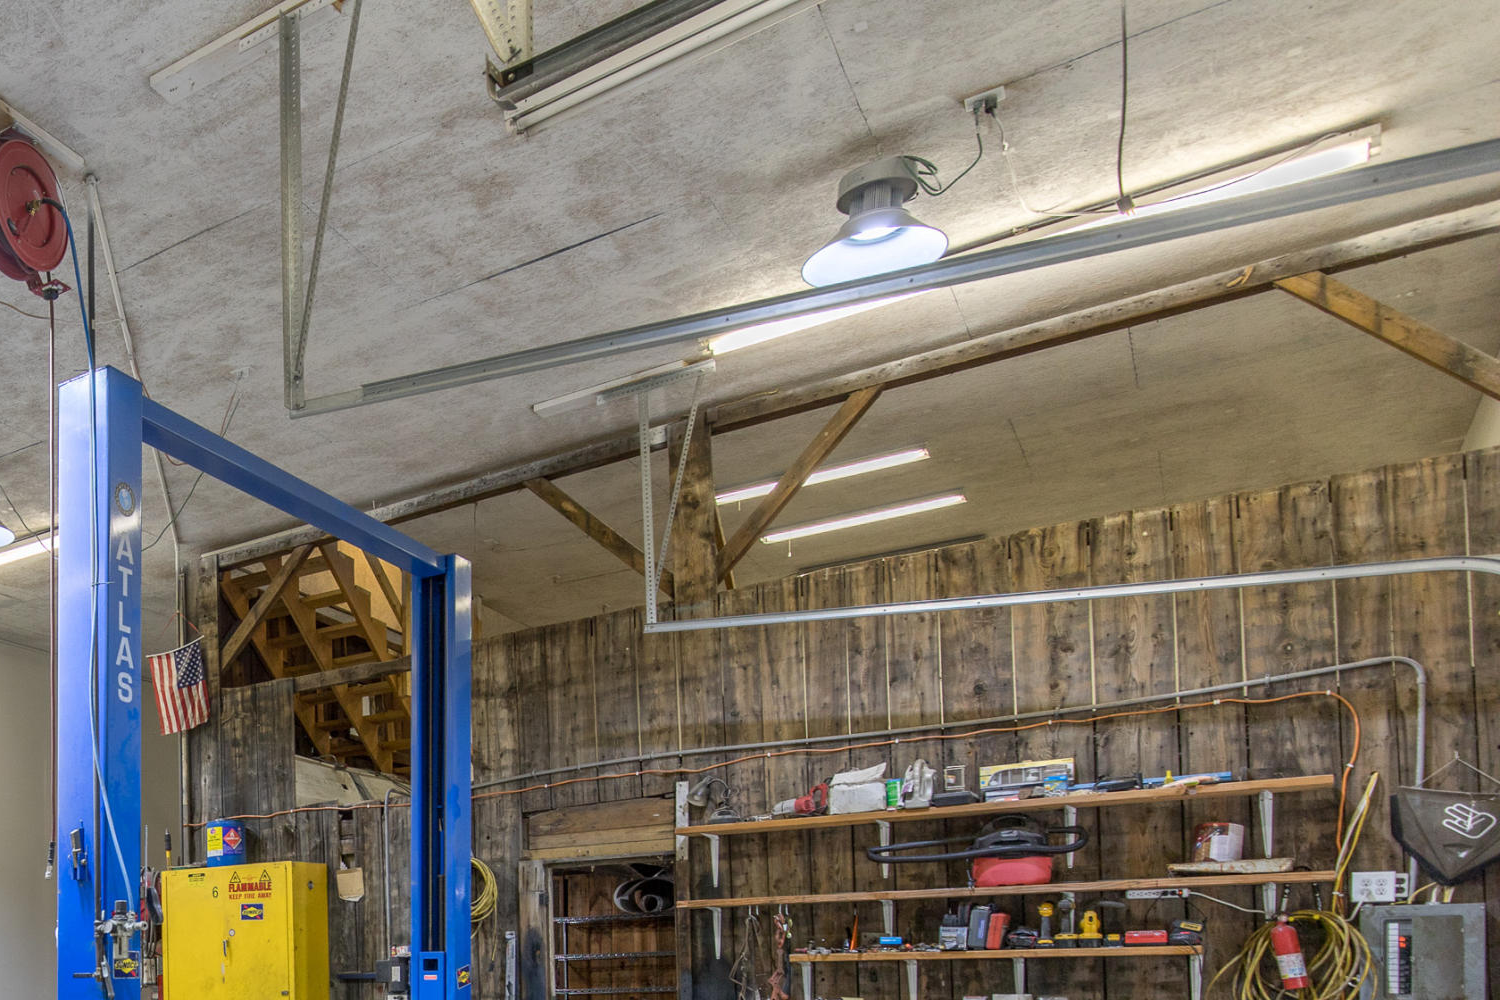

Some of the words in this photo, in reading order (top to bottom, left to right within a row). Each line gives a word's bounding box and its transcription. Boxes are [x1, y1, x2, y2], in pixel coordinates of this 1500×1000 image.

[115, 532, 135, 703] ATLAS
[212, 886, 219, 898] 6
[228, 882, 272, 893] FLAMMABLE
